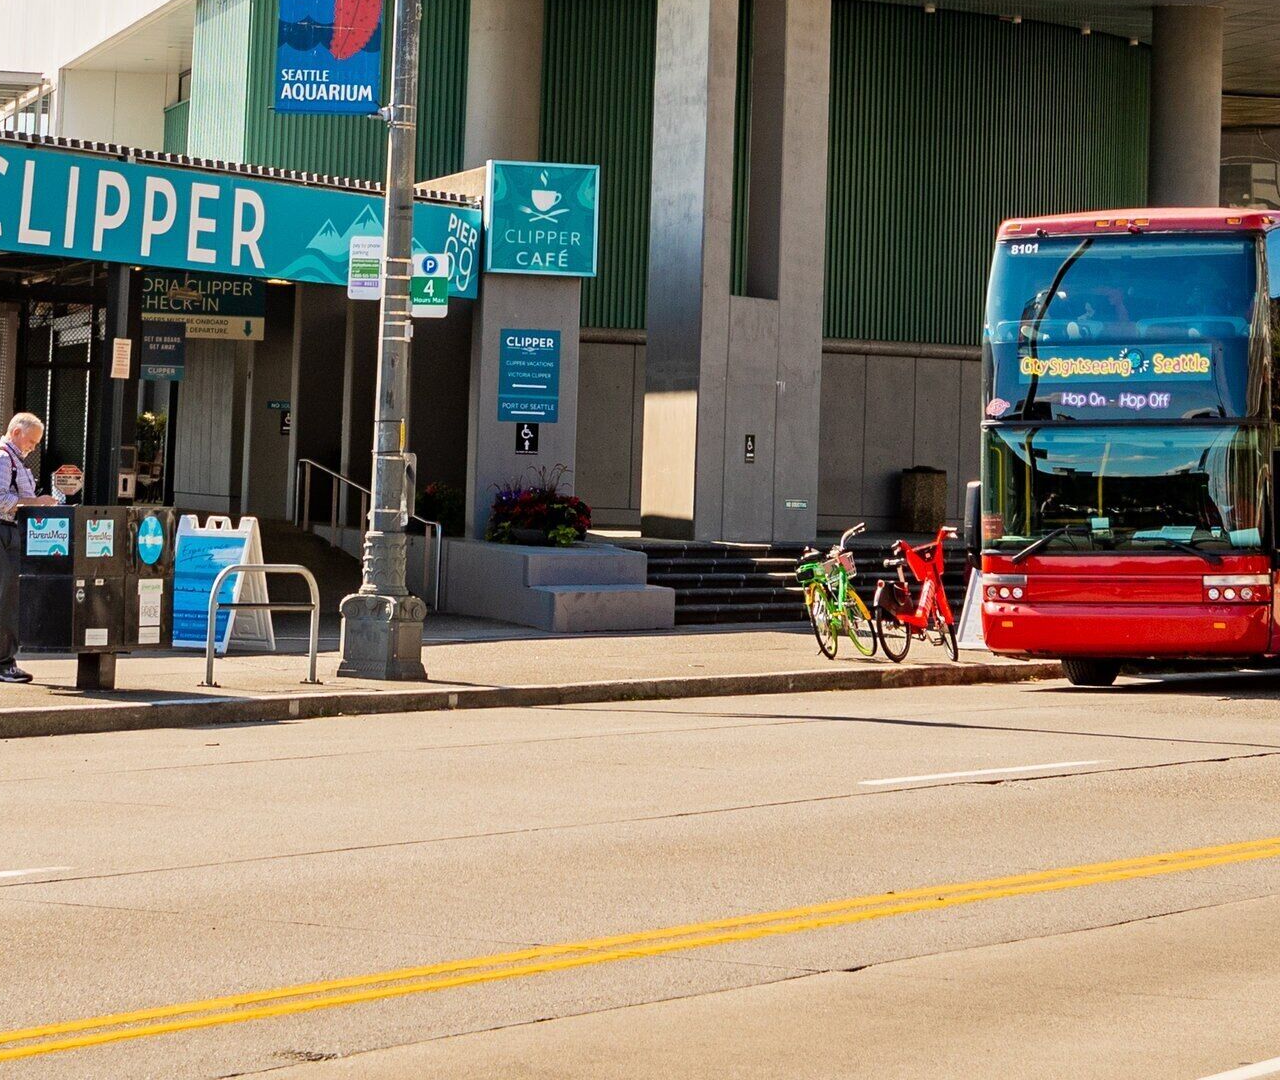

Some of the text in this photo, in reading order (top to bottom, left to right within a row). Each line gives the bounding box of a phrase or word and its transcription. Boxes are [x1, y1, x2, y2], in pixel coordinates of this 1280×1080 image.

[281, 69, 330, 82] SEATTLE
[280, 83, 372, 102] AQUARIUM
[448, 212, 478, 250] PIER
[504, 229, 581, 246] CLIPPER
[1010, 243, 1039, 255] 8101
[426, 260, 435, 272] P
[444, 236, 473, 292] 69
[516, 249, 569, 268] CAFÉ
[423, 279, 434, 297] 4
[142, 295, 219, 312] HECK-IN
[506, 336, 554, 348] CLIPPER
[1152, 353, 1210, 374] Seattle
[1061, 392, 1086, 407] Hop
[1088, 392, 1106, 406] On
[1119, 393, 1146, 410] Hop
[1148, 393, 1171, 408] Off
[28, 530, 68, 541] ParentMap
[88, 532, 112, 541] ParentMap
